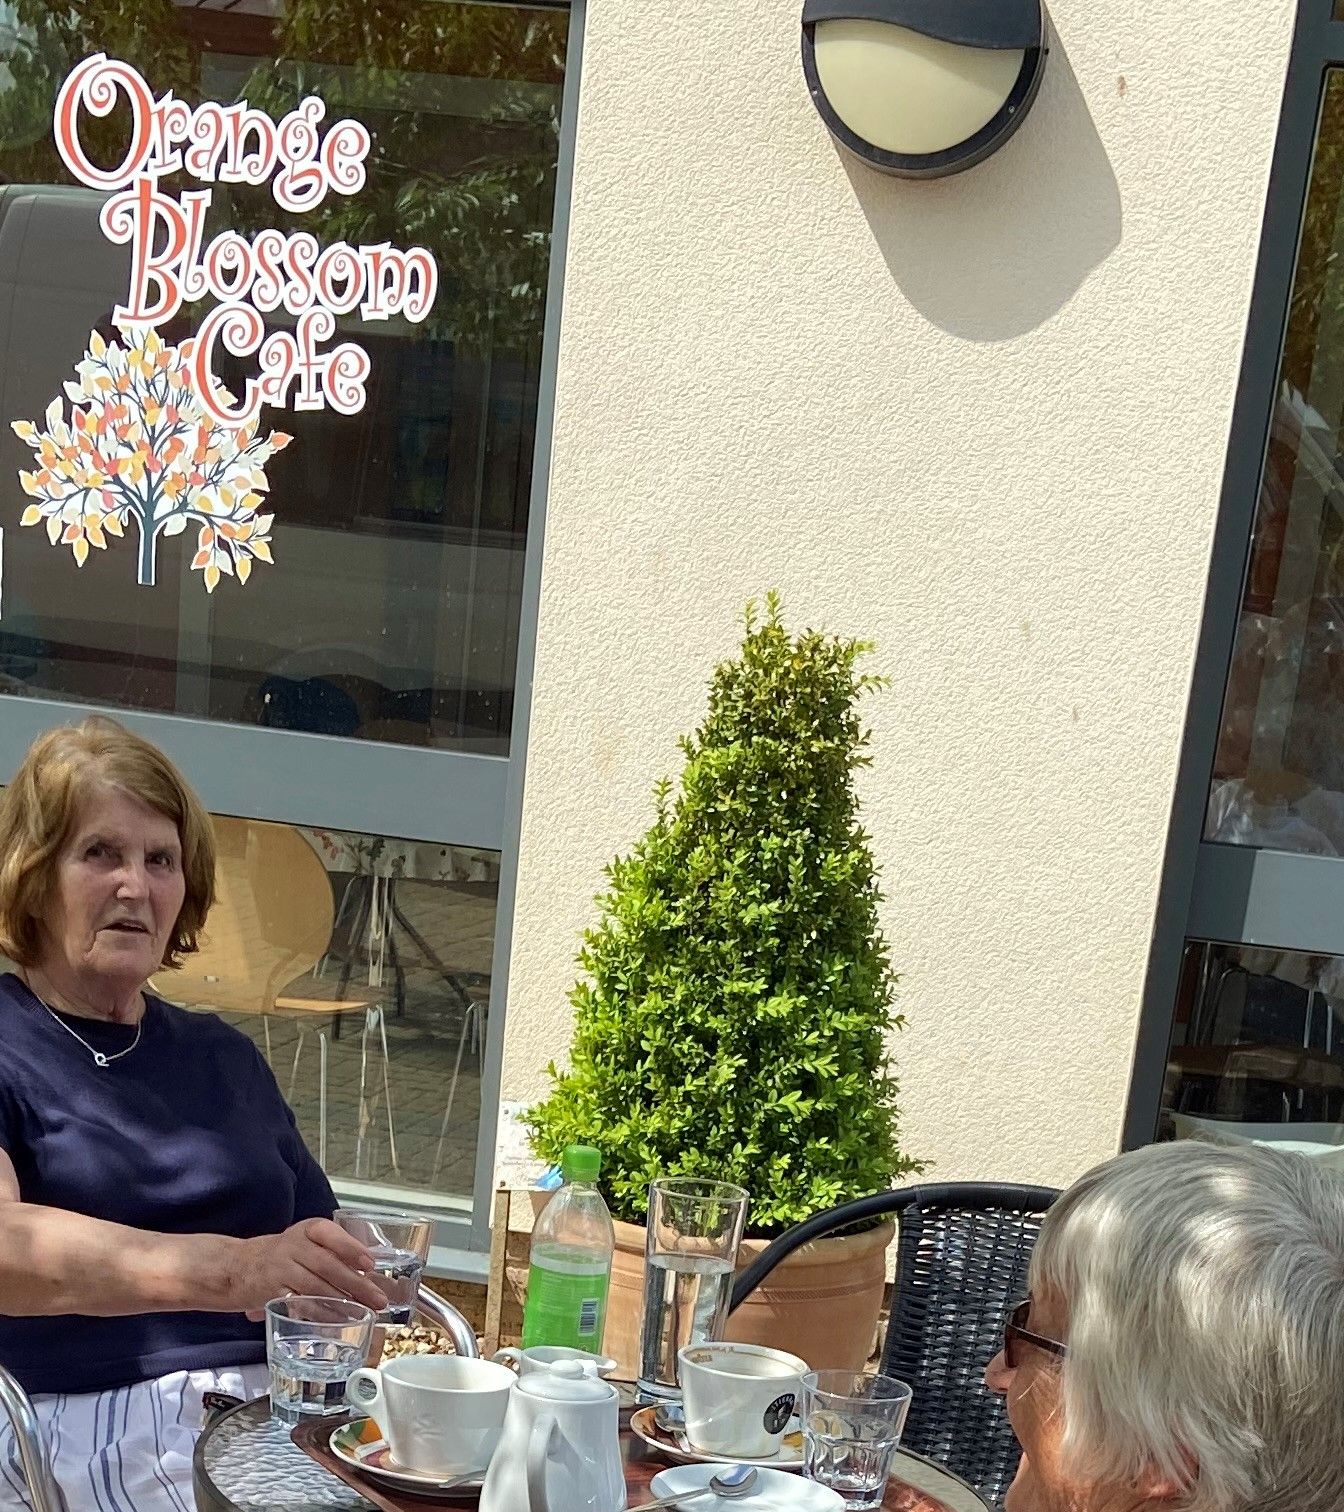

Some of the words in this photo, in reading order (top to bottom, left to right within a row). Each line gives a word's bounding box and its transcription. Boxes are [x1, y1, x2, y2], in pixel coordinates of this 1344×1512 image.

[55, 55, 369, 209] Orange
[101, 177, 436, 325] Blossom
[192, 303, 369, 425] Cafe
